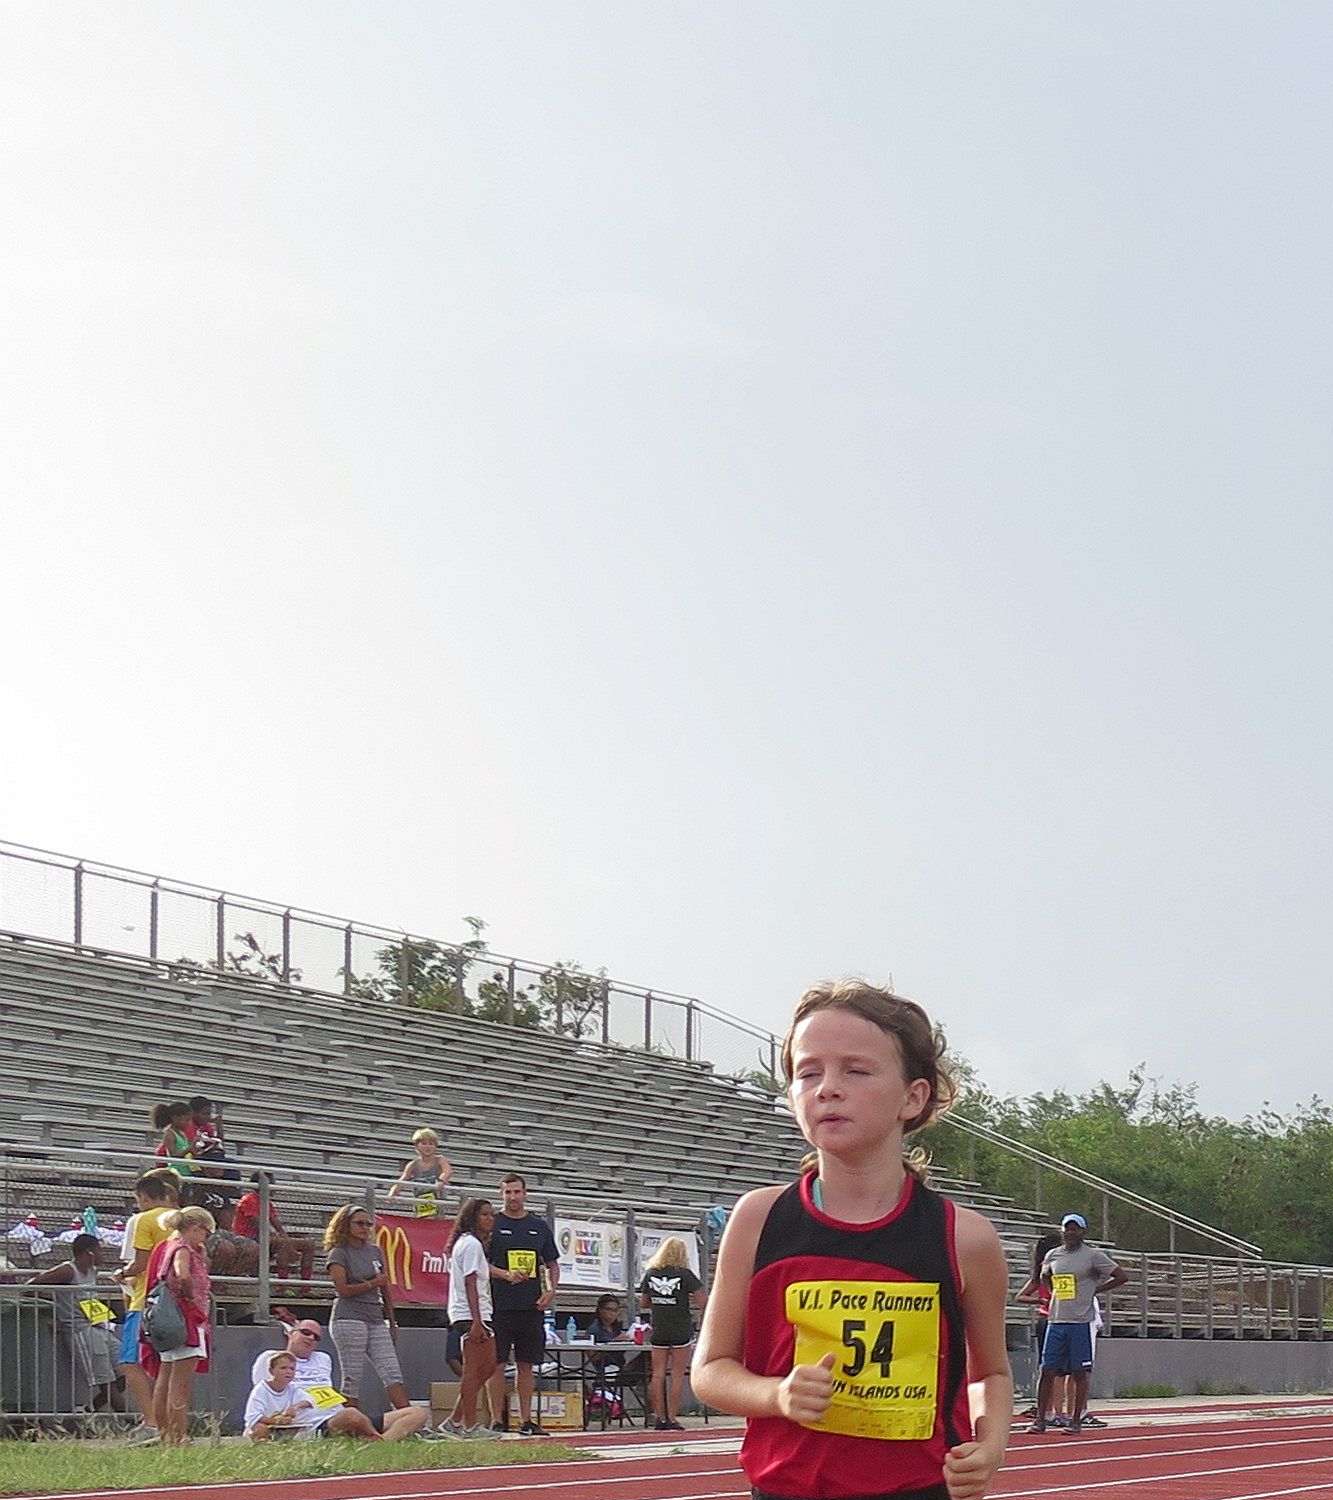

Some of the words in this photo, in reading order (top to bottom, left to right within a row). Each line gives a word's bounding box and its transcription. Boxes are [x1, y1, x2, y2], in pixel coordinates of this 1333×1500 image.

[799, 1289, 824, 1310] V.I.
[829, 1290, 868, 1311] Pace
[872, 1291, 934, 1313] Runners
[842, 1319, 895, 1378] 54
[849, 1386, 901, 1400] ISLANDS
